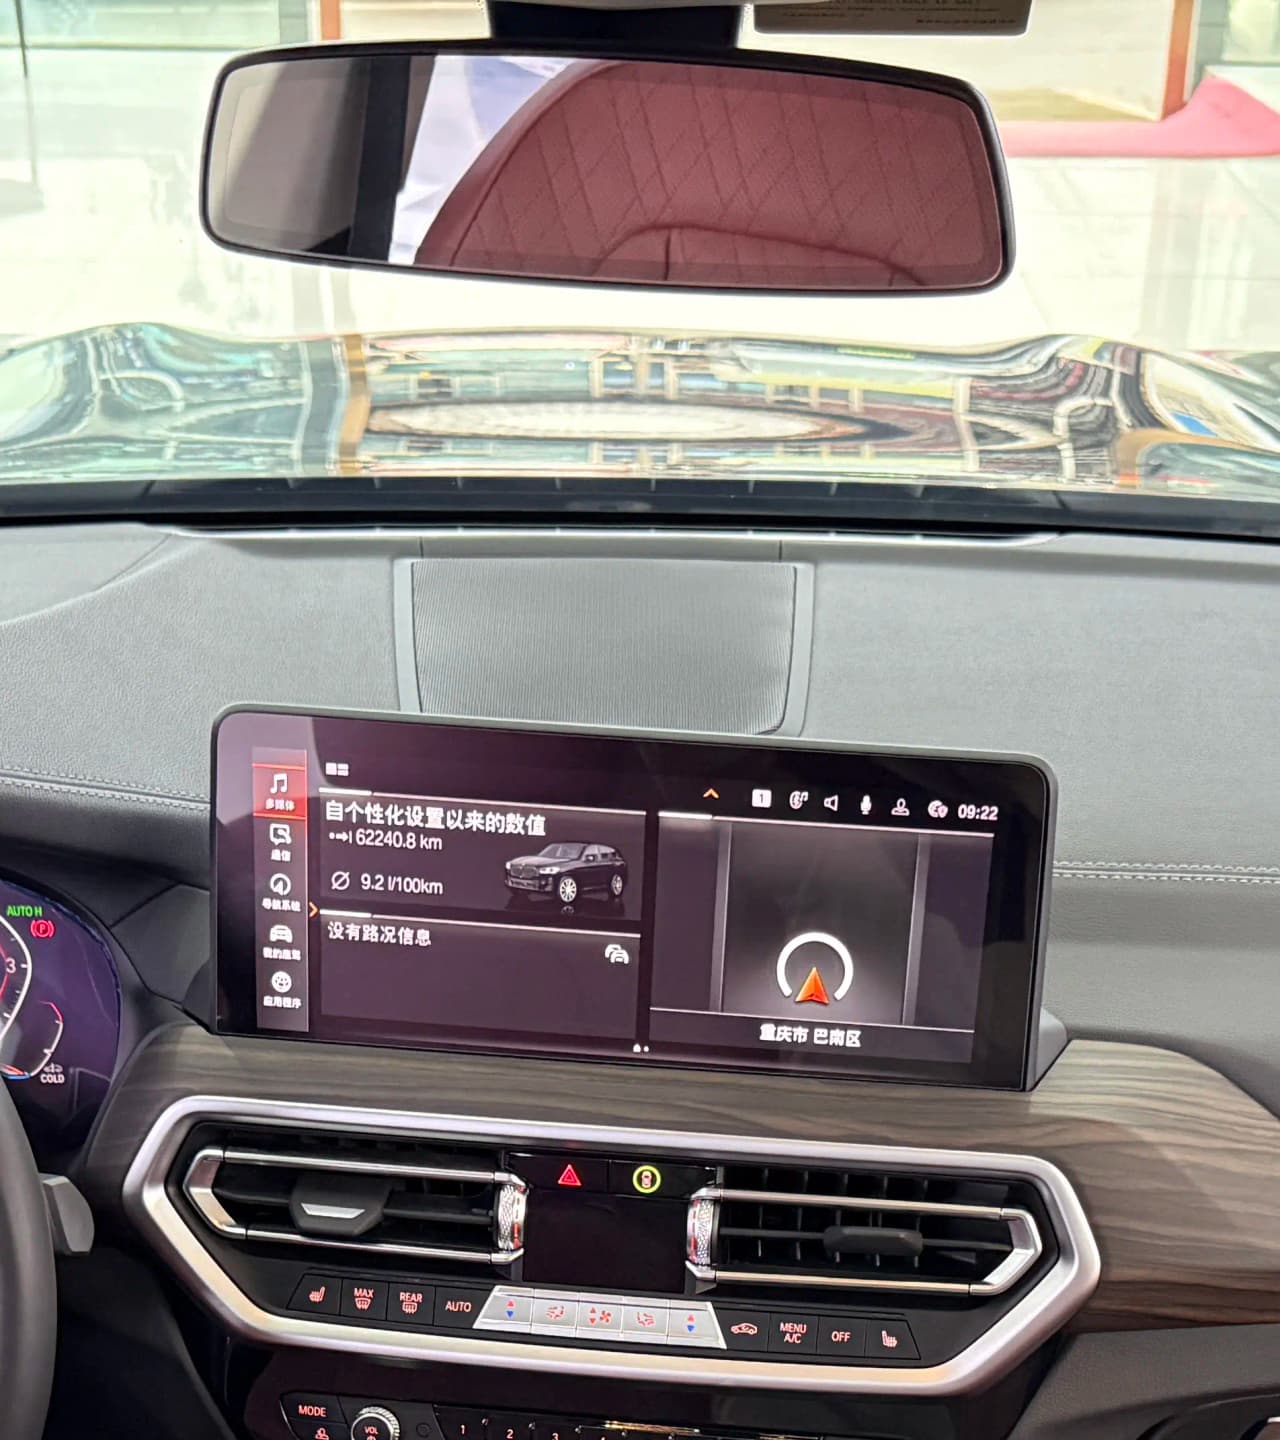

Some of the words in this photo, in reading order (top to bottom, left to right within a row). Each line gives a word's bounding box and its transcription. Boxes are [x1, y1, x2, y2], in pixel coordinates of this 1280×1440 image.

[325, 800, 546, 836] 自个性化设置以来的数值
[957, 803, 999, 821] 09:22
[356, 828, 416, 849] 62240.8
[419, 834, 443, 850] km
[360, 873, 384, 891] 9.2
[6, 905, 33, 917] AUTO
[35, 906, 43, 917] H
[327, 920, 432, 946] 没有路况信息
[6, 958, 16, 973] 3
[759, 1023, 809, 1043] 重庆市
[813, 1028, 861, 1047] 巴南区
[40, 1072, 65, 1084] COLD
[354, 1287, 374, 1298] MAX
[399, 1292, 422, 1302] REAR
[445, 1300, 472, 1313] AUTO
[780, 1322, 807, 1334] MENU
[784, 1333, 802, 1344] A/C
[831, 1331, 852, 1343] OFF
[298, 1404, 327, 1418] MODE
[364, 1426, 378, 1435] VOL
[460, 1425, 465, 1435] 1
[506, 1429, 513, 1440] 2
